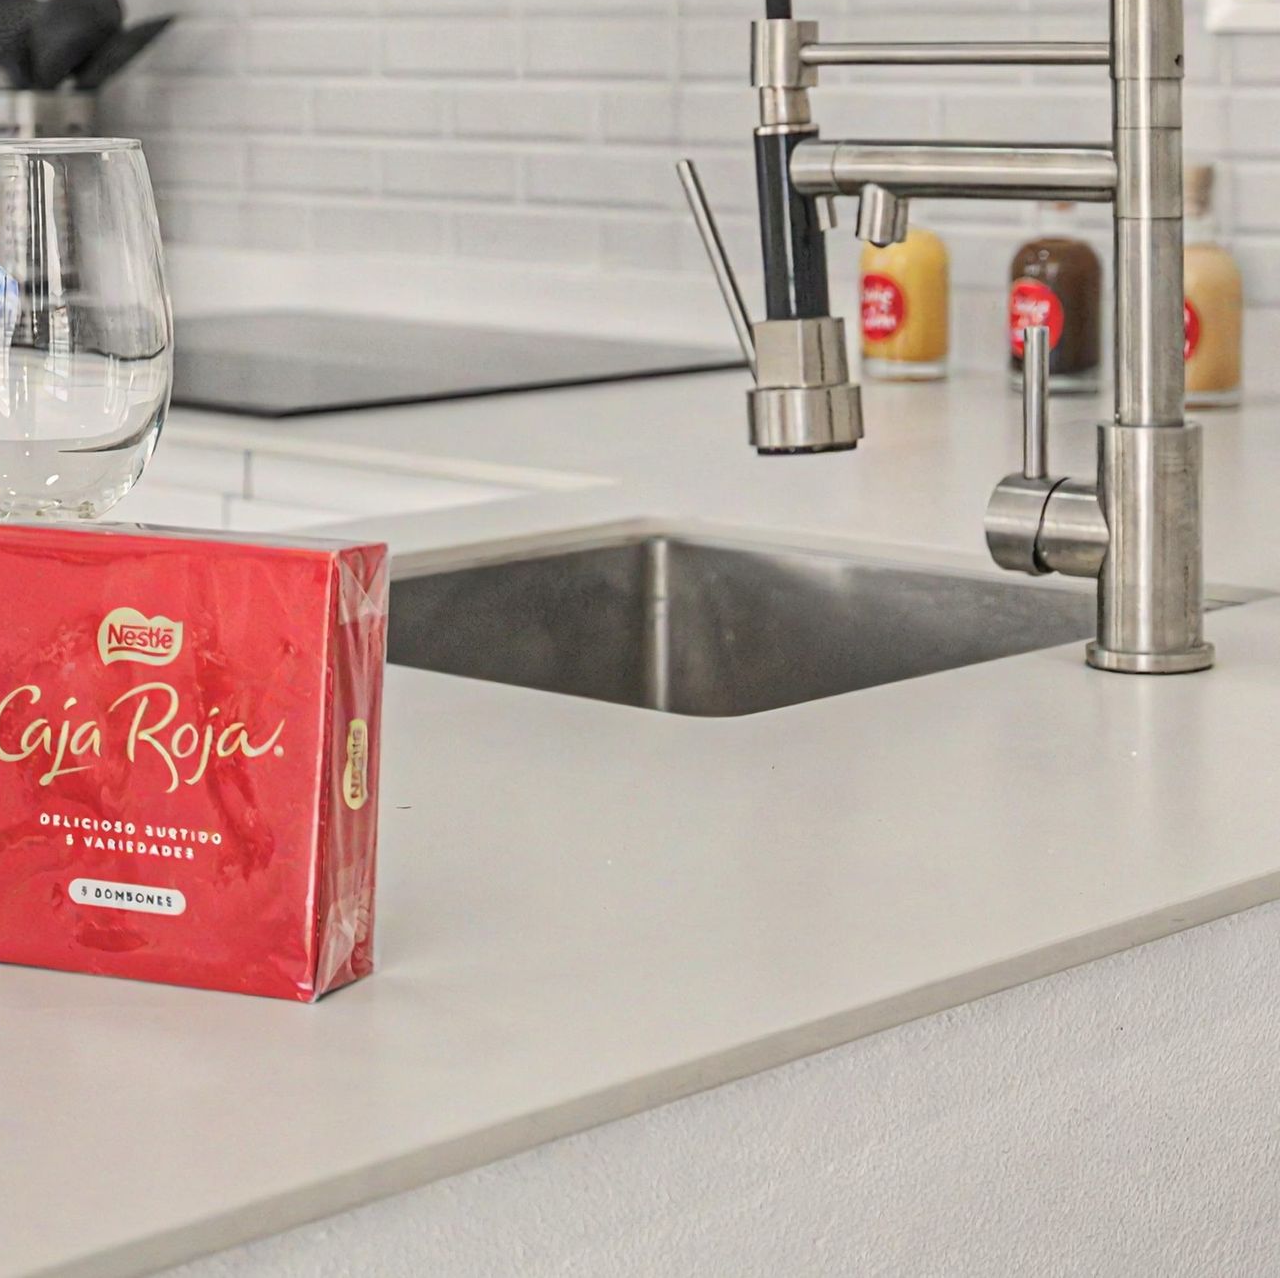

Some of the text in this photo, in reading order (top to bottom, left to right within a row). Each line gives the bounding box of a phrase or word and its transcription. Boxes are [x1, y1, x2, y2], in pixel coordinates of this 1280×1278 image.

[108, 623, 174, 650] Nestlé
[39, 812, 223, 846] DELICIOSO SURTIDO
[83, 835, 195, 861] VARIEDADES
[94, 887, 173, 908] BOMBONES
